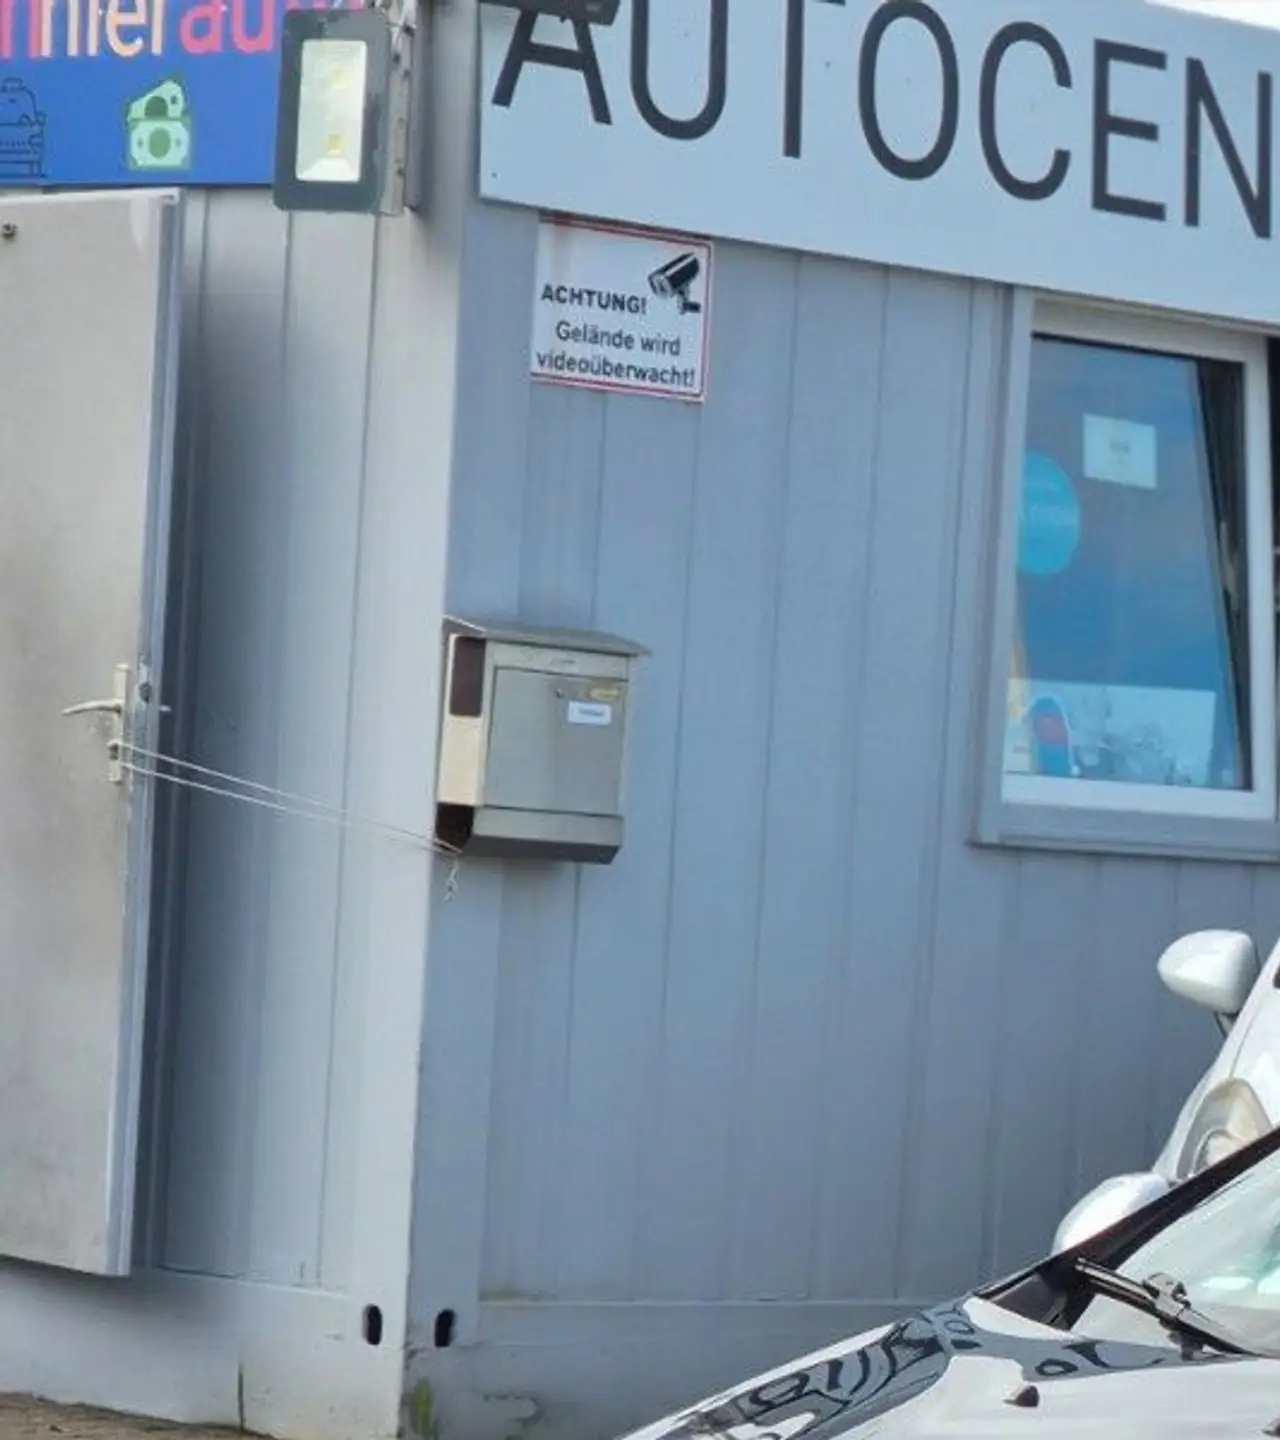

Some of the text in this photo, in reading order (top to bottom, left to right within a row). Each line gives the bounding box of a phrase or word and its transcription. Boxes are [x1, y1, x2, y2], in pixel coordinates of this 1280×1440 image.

[541, 284, 647, 315] ACHTUNG!
[556, 320, 681, 357] Gelände wird
[536, 350, 696, 388] videoüberwacht!
